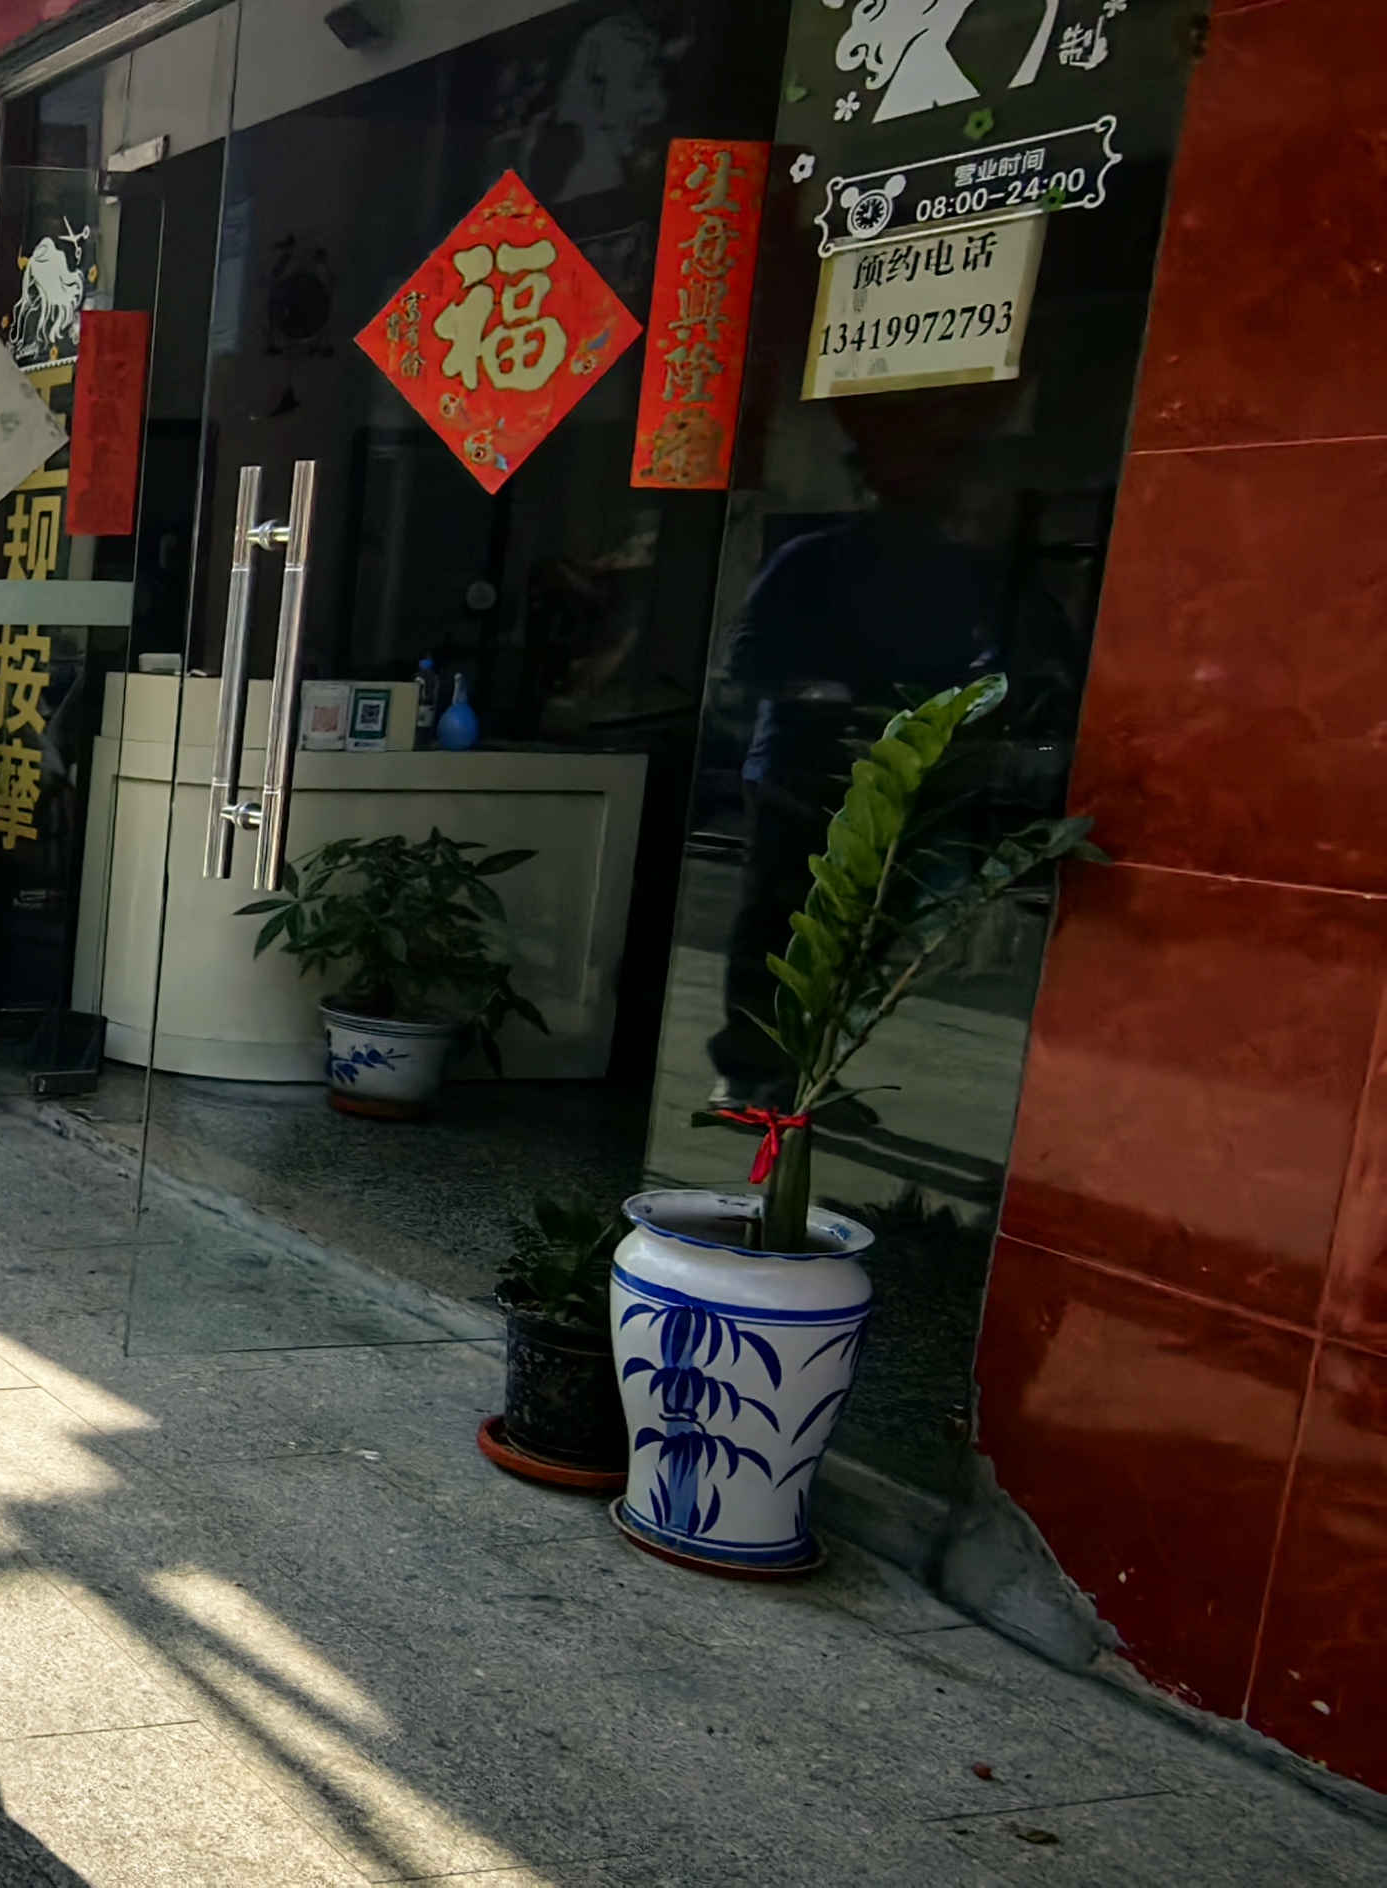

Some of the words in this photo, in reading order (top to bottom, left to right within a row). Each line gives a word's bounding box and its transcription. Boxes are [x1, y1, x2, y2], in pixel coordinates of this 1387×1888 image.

[955, 148, 1045, 188] 营业时间
[853, 231, 997, 290] 预约电话
[433, 239, 569, 392] 福
[819, 301, 1013, 357] 13419972793
